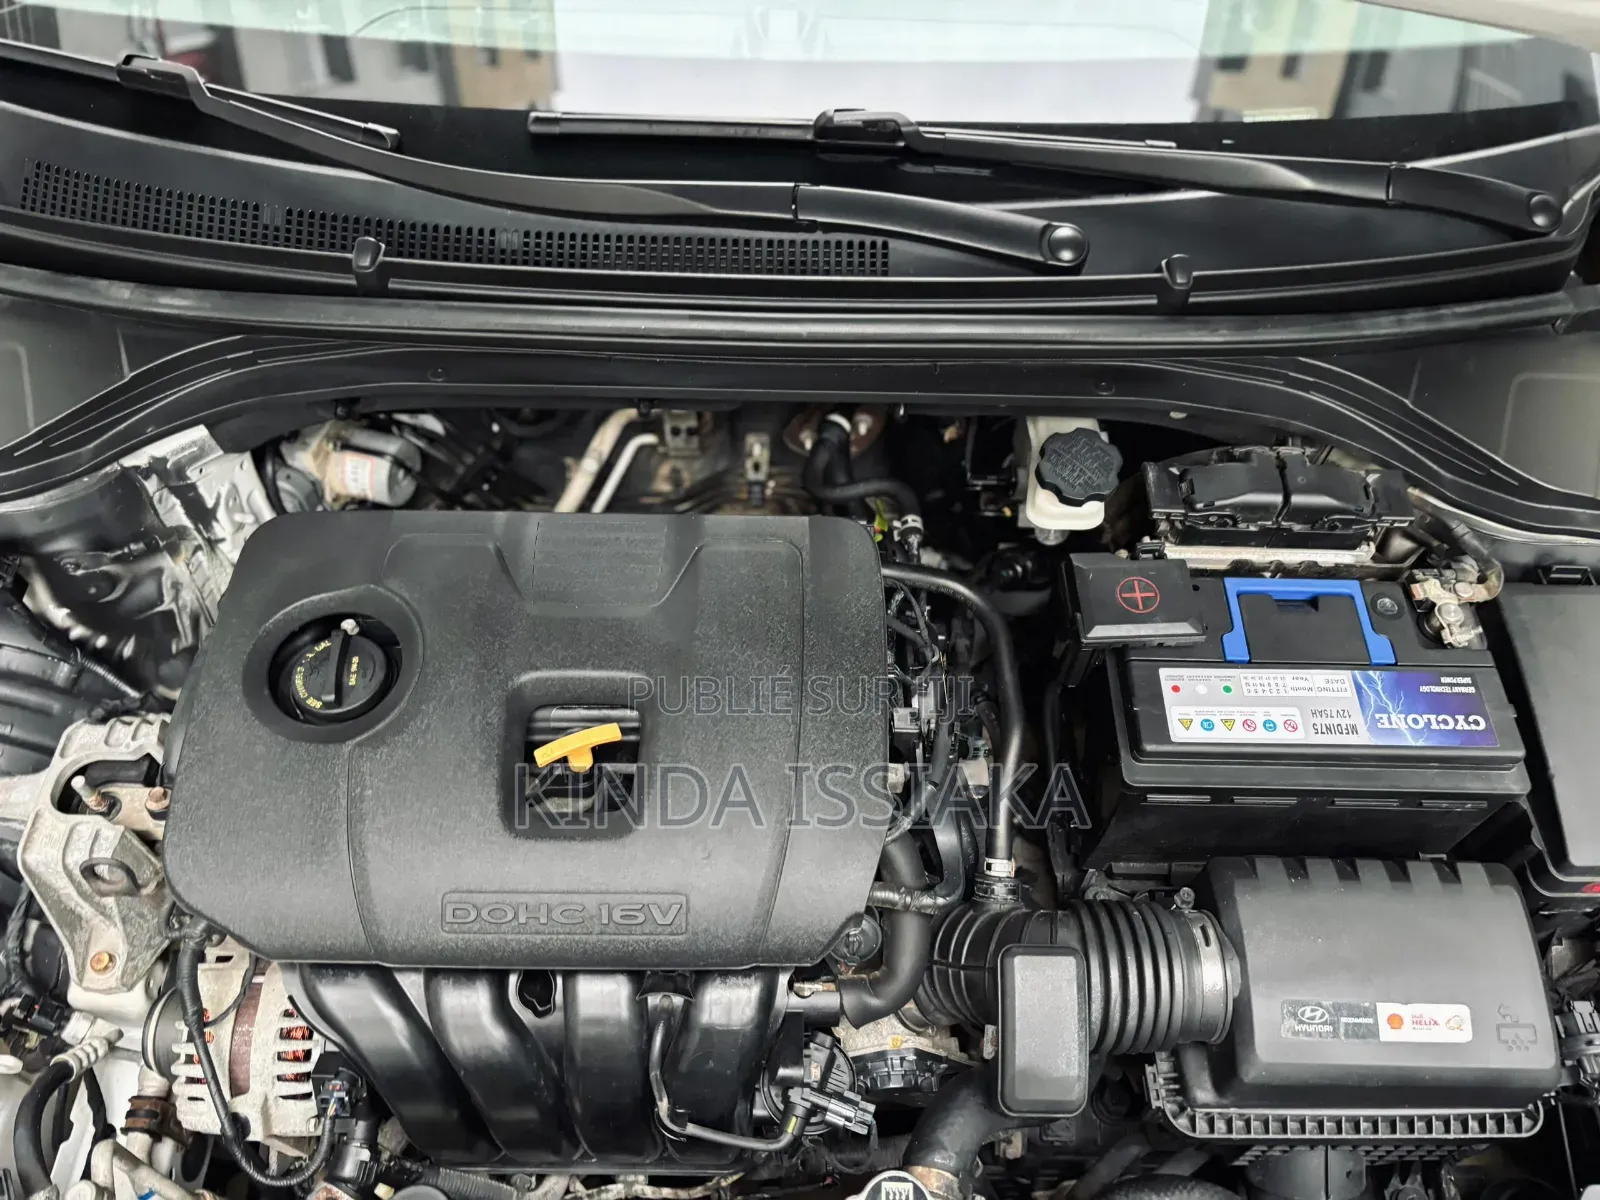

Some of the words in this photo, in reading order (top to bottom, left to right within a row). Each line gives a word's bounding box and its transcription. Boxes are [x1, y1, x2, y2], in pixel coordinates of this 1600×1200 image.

[306, 697, 322, 708] SEE
[1310, 708, 1334, 718] 75AH
[1336, 709, 1352, 718] 12V
[1374, 712, 1486, 730] CYCLONE
[1312, 722, 1358, 736] MFDIN75
[444, 901, 586, 926] DOHC
[599, 901, 683, 927] 16V
[1412, 1018, 1440, 1026] HELIX
[1295, 1024, 1333, 1032] HYUNDAI
